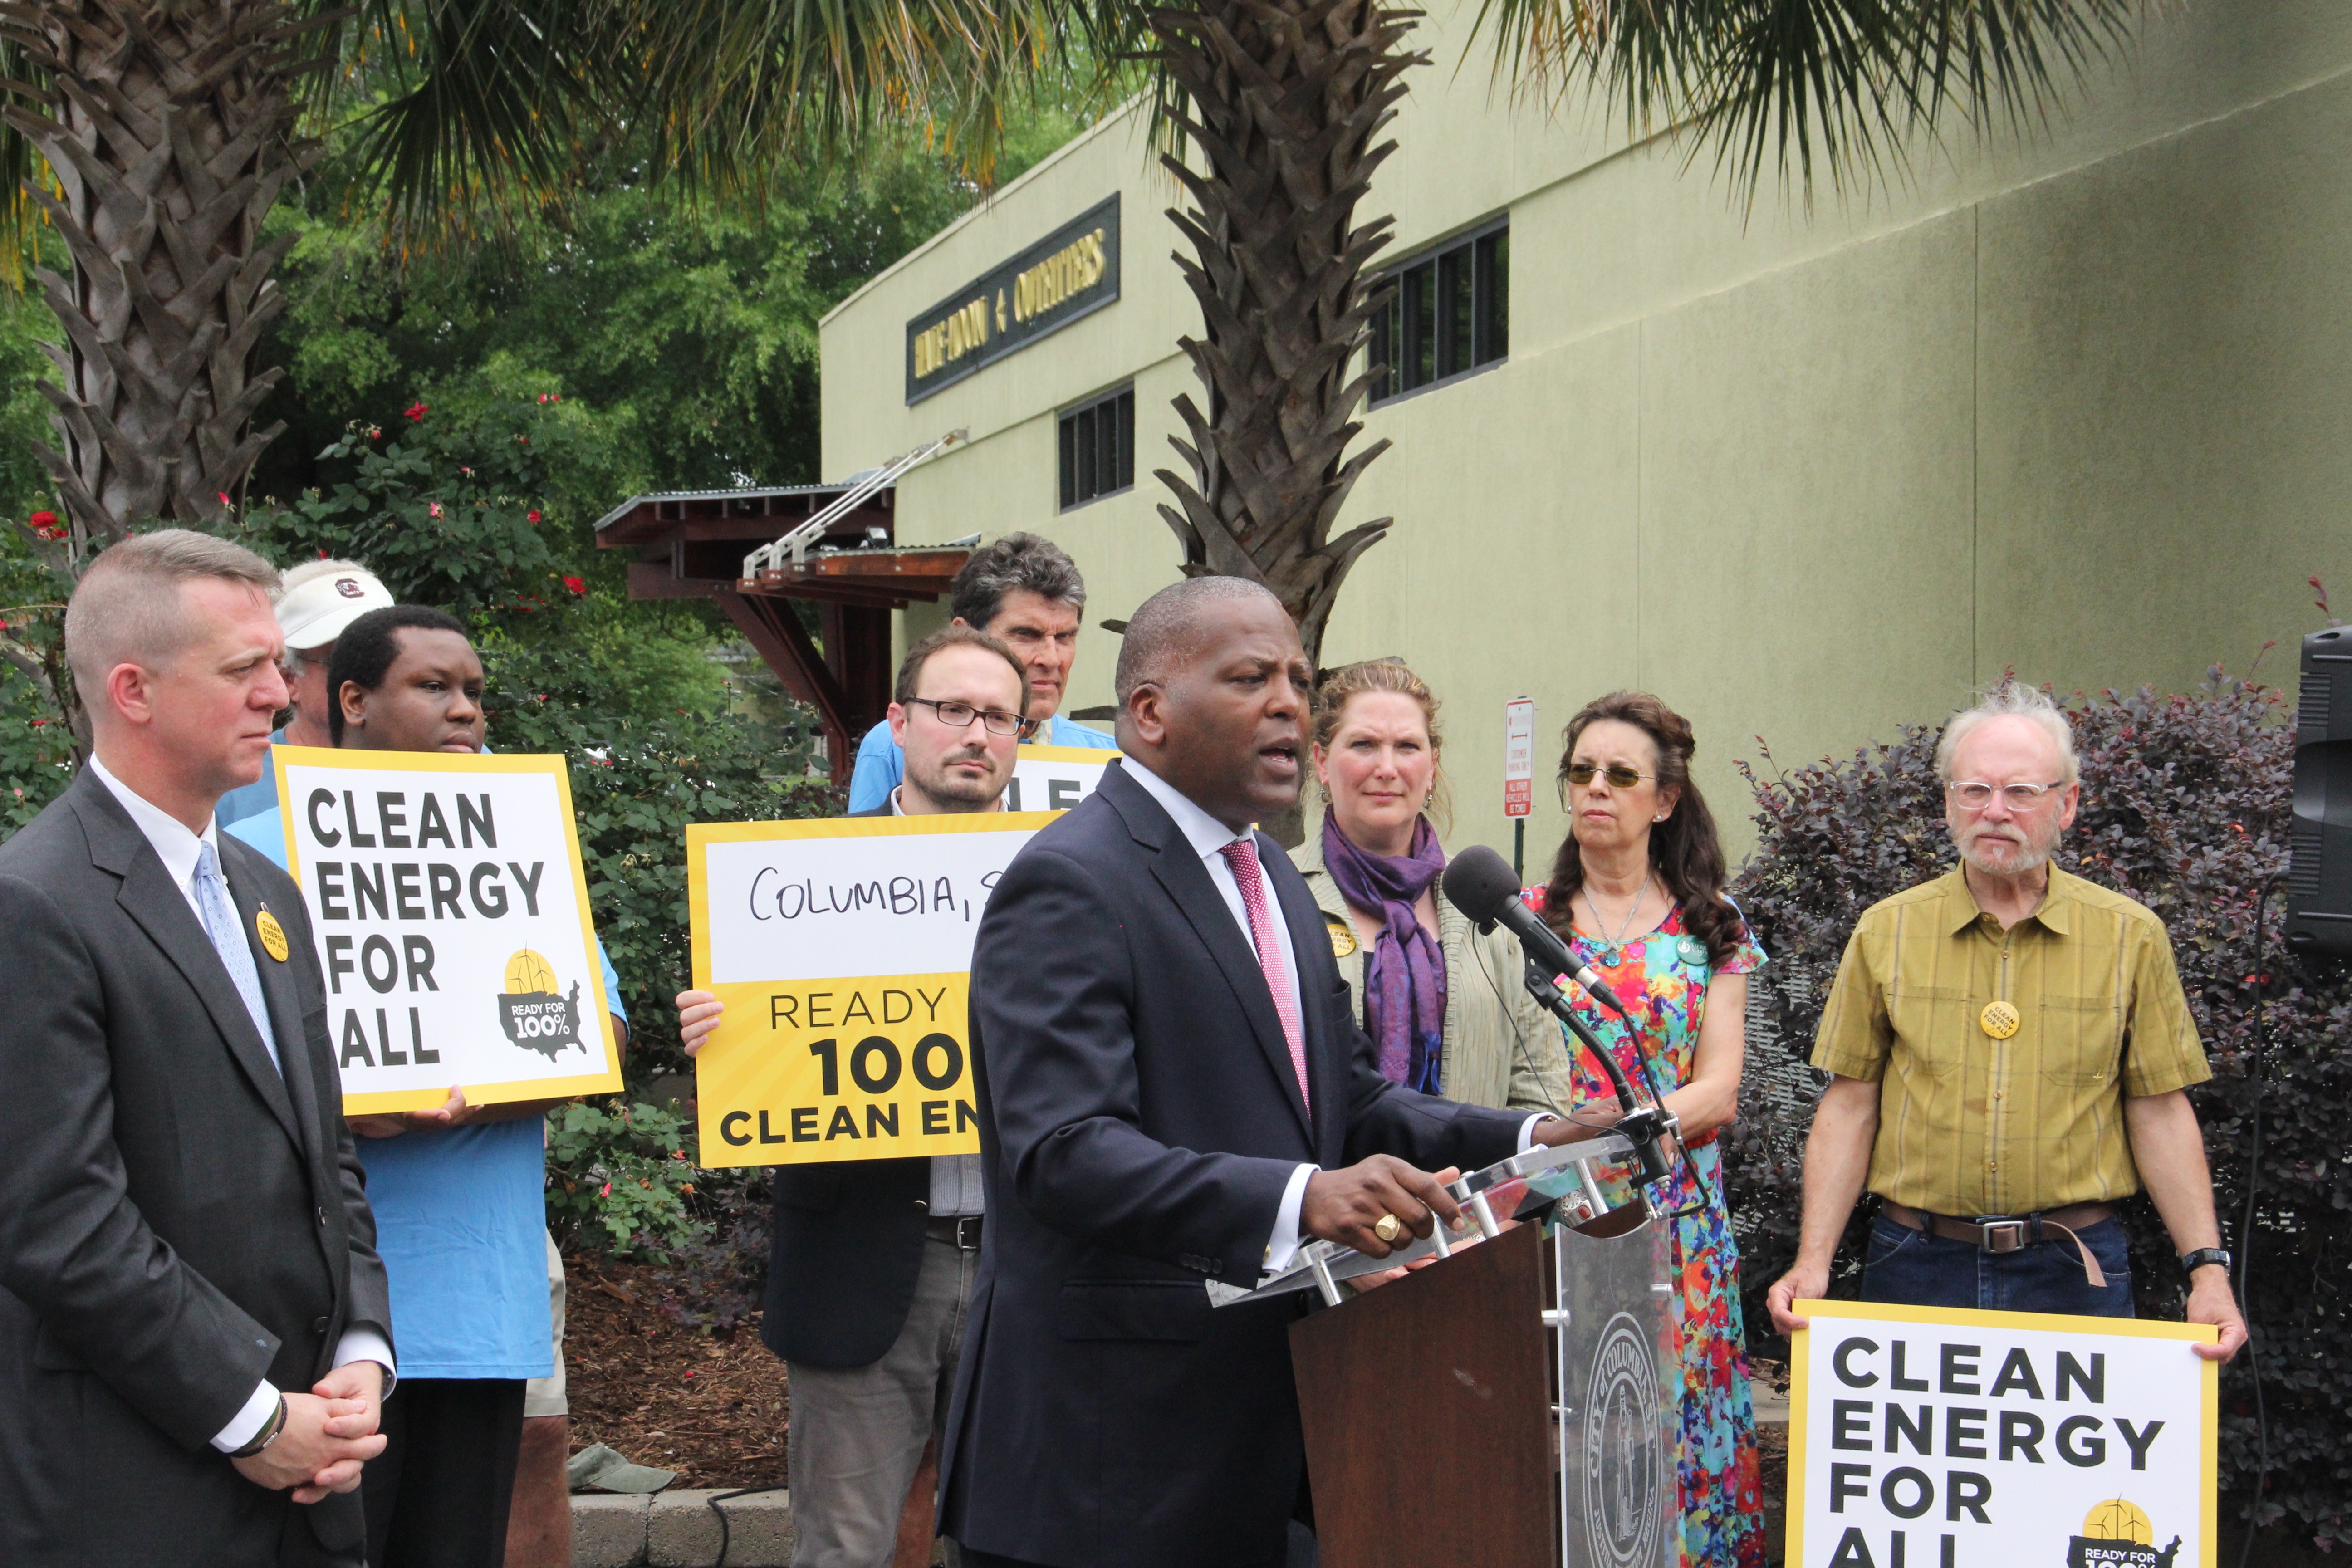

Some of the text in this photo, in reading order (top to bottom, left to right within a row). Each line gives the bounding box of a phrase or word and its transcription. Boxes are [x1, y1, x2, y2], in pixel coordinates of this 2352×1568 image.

[308, 787, 497, 849] CLEAN
[316, 861, 545, 921] ENERGY
[749, 866, 970, 922] COLUMBIA,
[263, 921, 280, 934] CLEAN
[263, 928, 284, 942] ENERGY
[265, 936, 287, 952] FOR ALL
[327, 934, 439, 995] FOR
[511, 1002, 566, 1016] READY FOR
[514, 1014, 570, 1039] 100%
[770, 986, 947, 1030] READY
[1984, 1014, 2008, 1037] FOR ALL
[1988, 1010, 2013, 1030] ENERGY
[1994, 1006, 2015, 1024] CLEAN
[339, 1007, 441, 1068] ALL
[808, 1032, 963, 1096] 100
[720, 1102, 899, 1147] CLEAN
[1832, 1336, 2106, 1404] CLEAN
[1590, 1393, 1602, 1478] CITY
[1831, 1398, 2166, 1471] ENERGY
[1829, 1461, 1993, 1525] FOR
[2085, 1548, 2156, 1563] READY FOR
